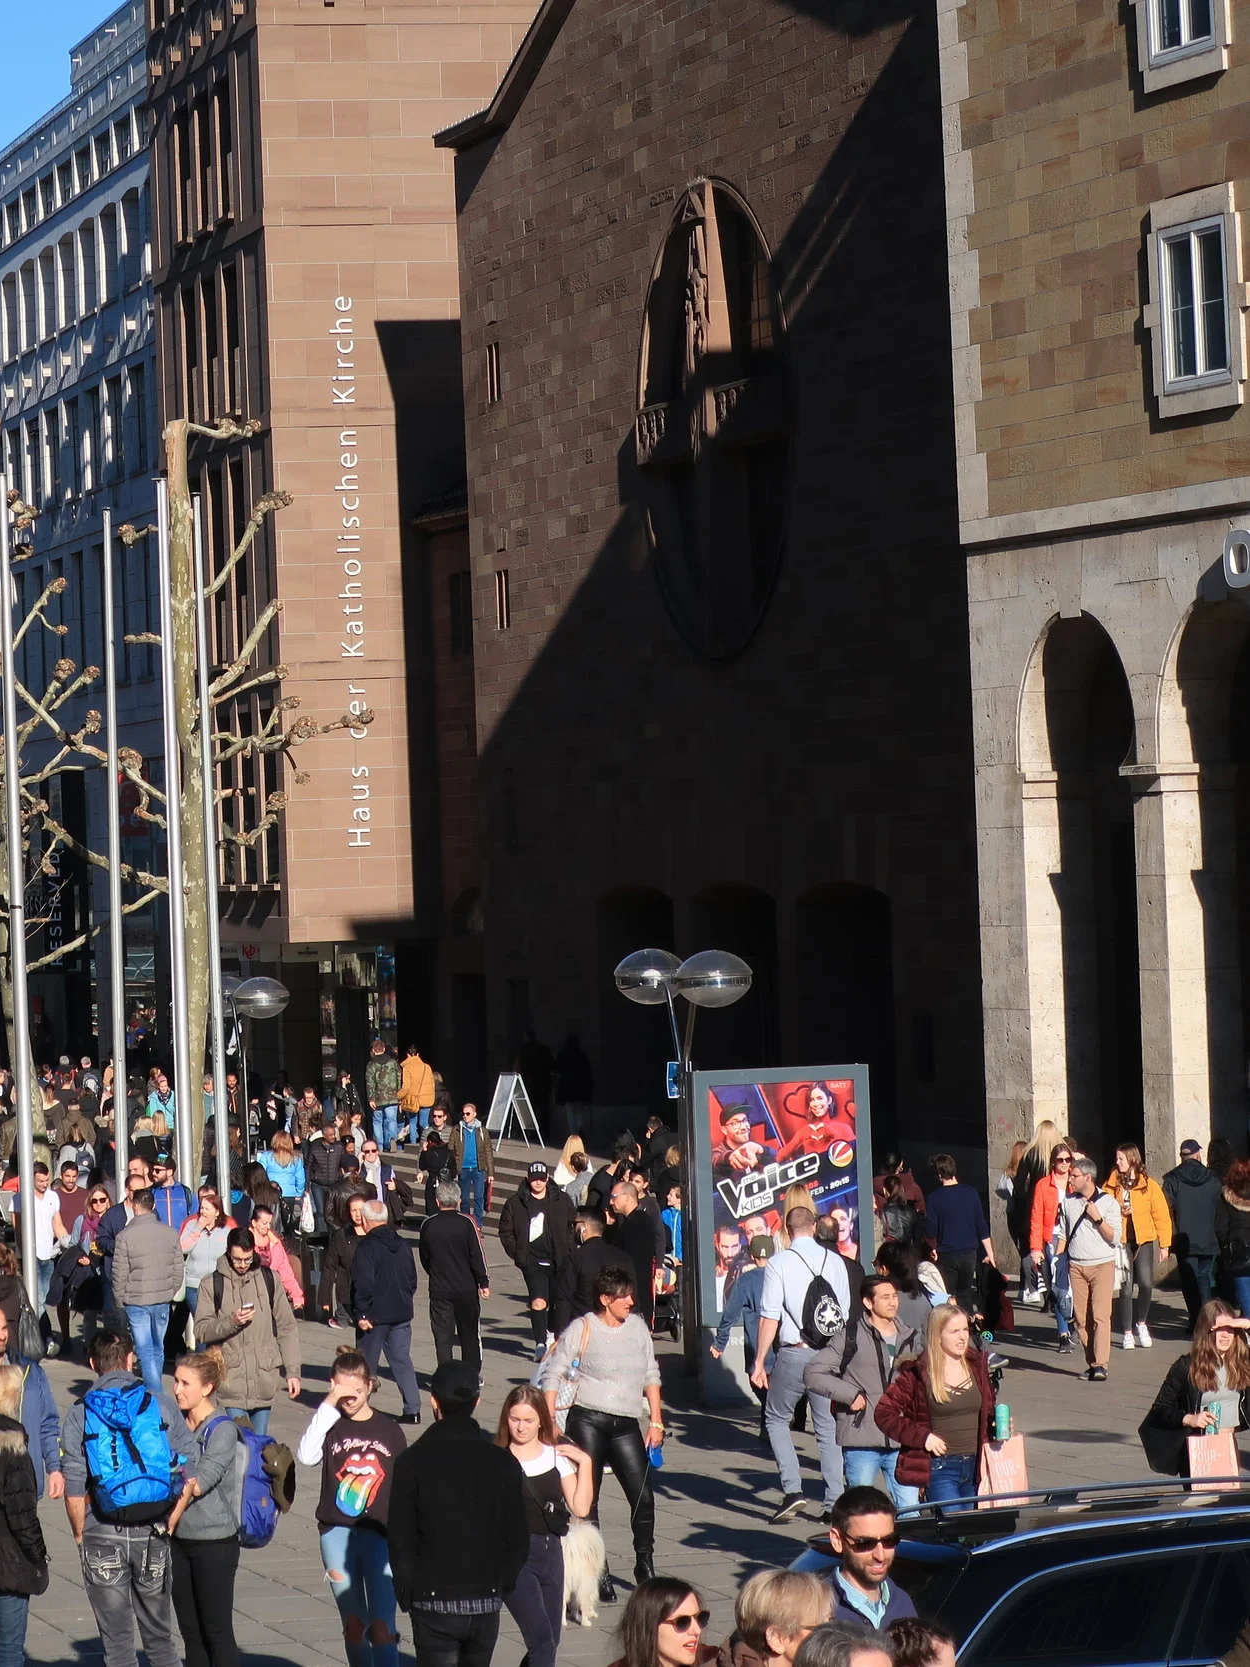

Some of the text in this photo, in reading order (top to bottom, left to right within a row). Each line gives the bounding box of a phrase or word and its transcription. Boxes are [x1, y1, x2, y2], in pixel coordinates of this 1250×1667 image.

[329, 295, 356, 404] Kirche
[335, 429, 364, 658] Katholischen
[347, 765, 372, 847] Haus
[48, 851, 64, 967] RESERVED
[718, 1154, 819, 1217] Voice
[741, 1192, 772, 1214] KIDS
